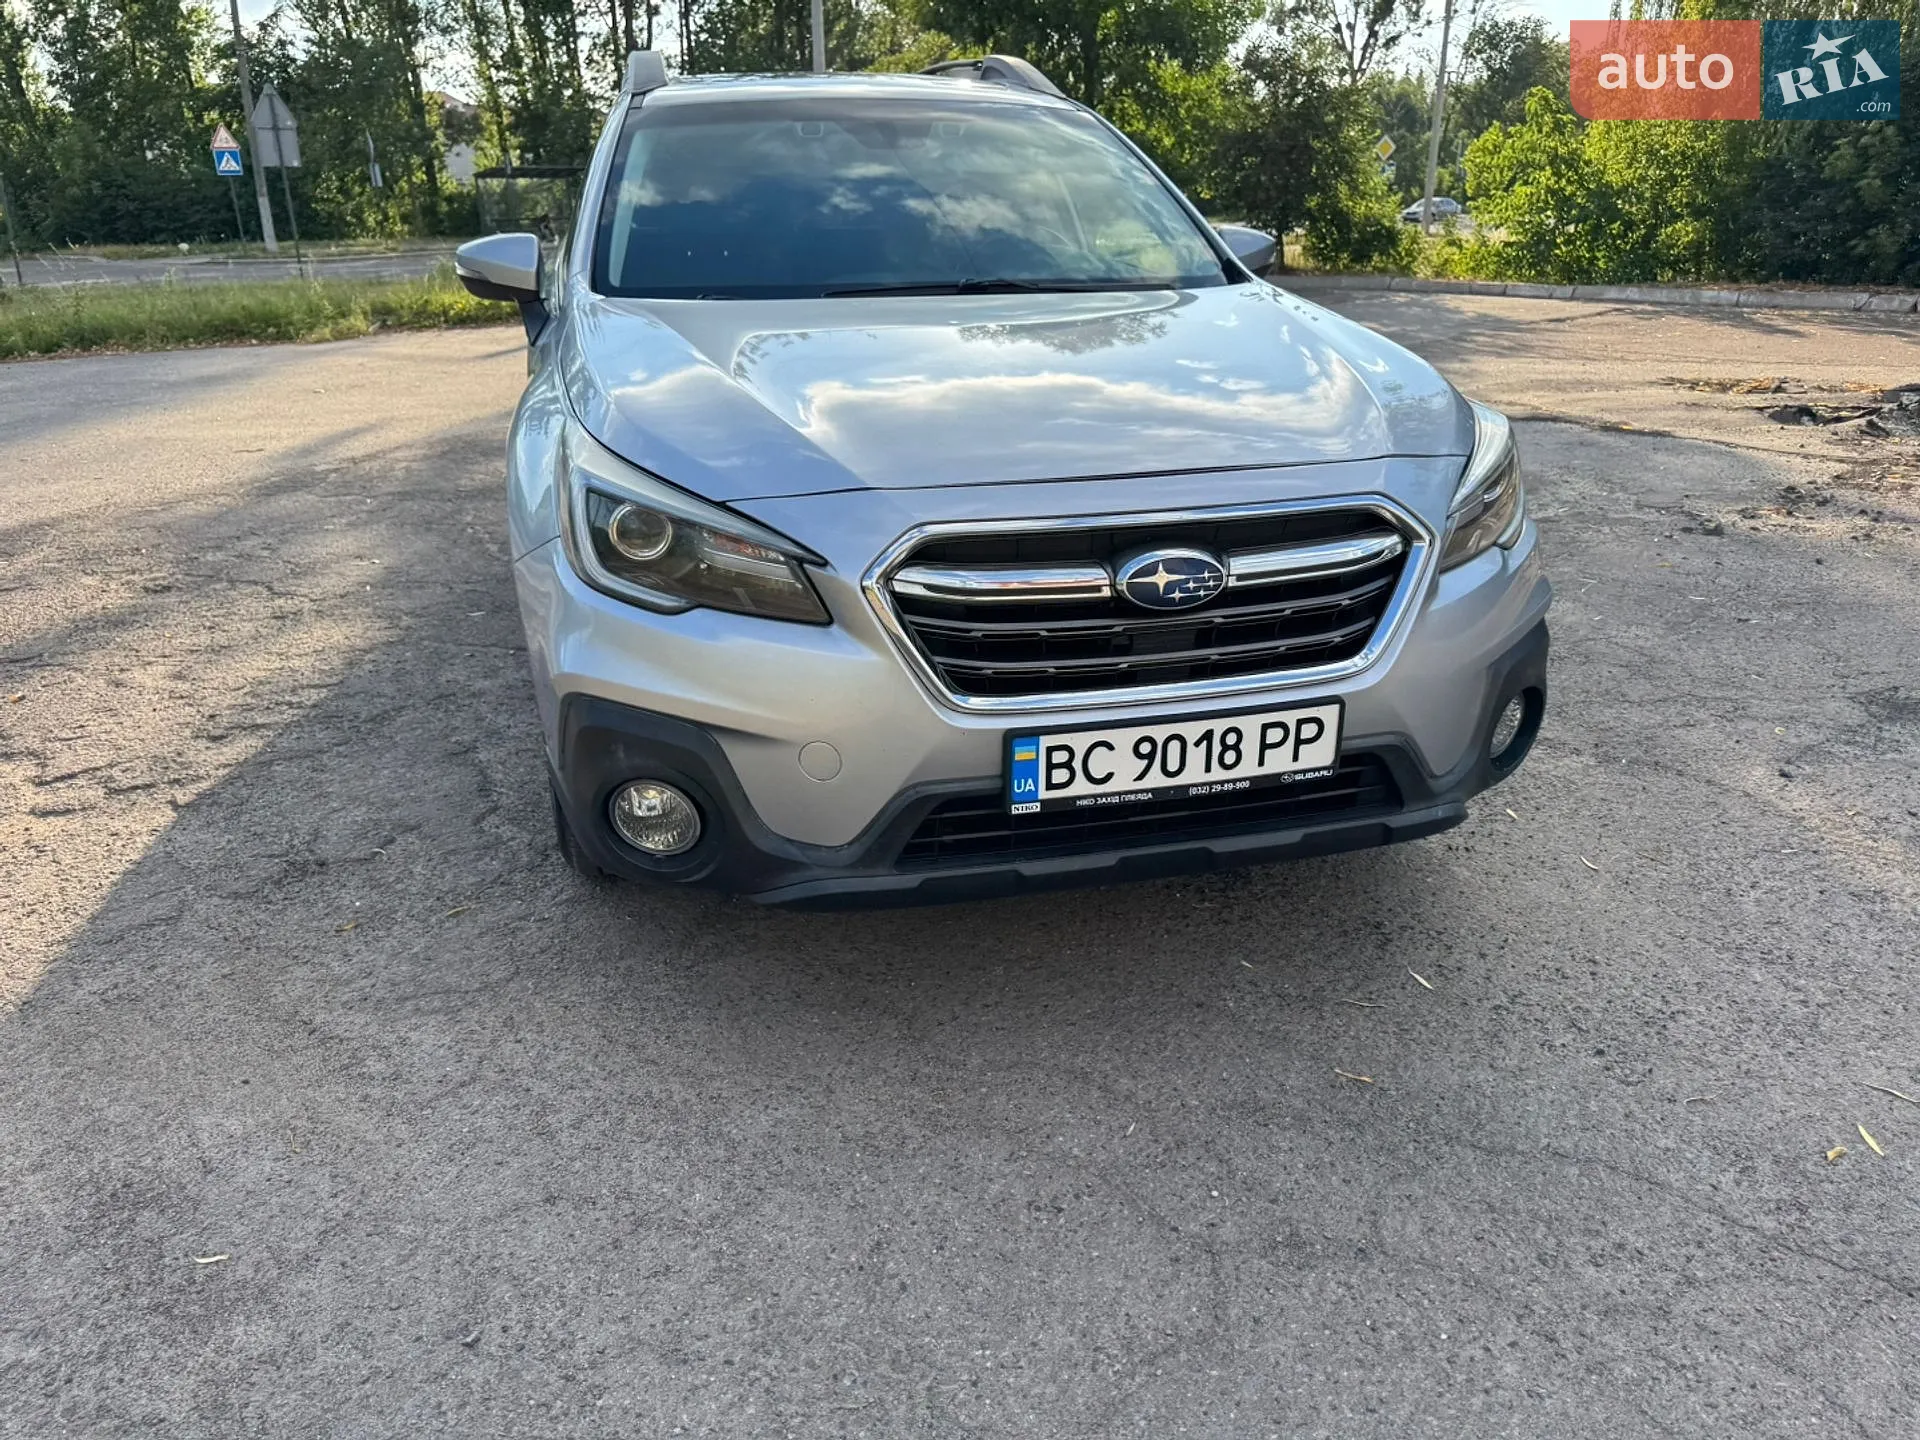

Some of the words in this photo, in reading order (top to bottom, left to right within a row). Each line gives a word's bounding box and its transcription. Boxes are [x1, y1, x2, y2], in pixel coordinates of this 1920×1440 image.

[1045, 739, 1116, 792] BC
[1132, 726, 1244, 782] 9018
[1257, 715, 1326, 768] PP
[1294, 769, 1334, 780] SUBARU
[1014, 778, 1036, 793] UA
[1189, 786, 1209, 796] (032)
[1013, 803, 1040, 813] NIKO
